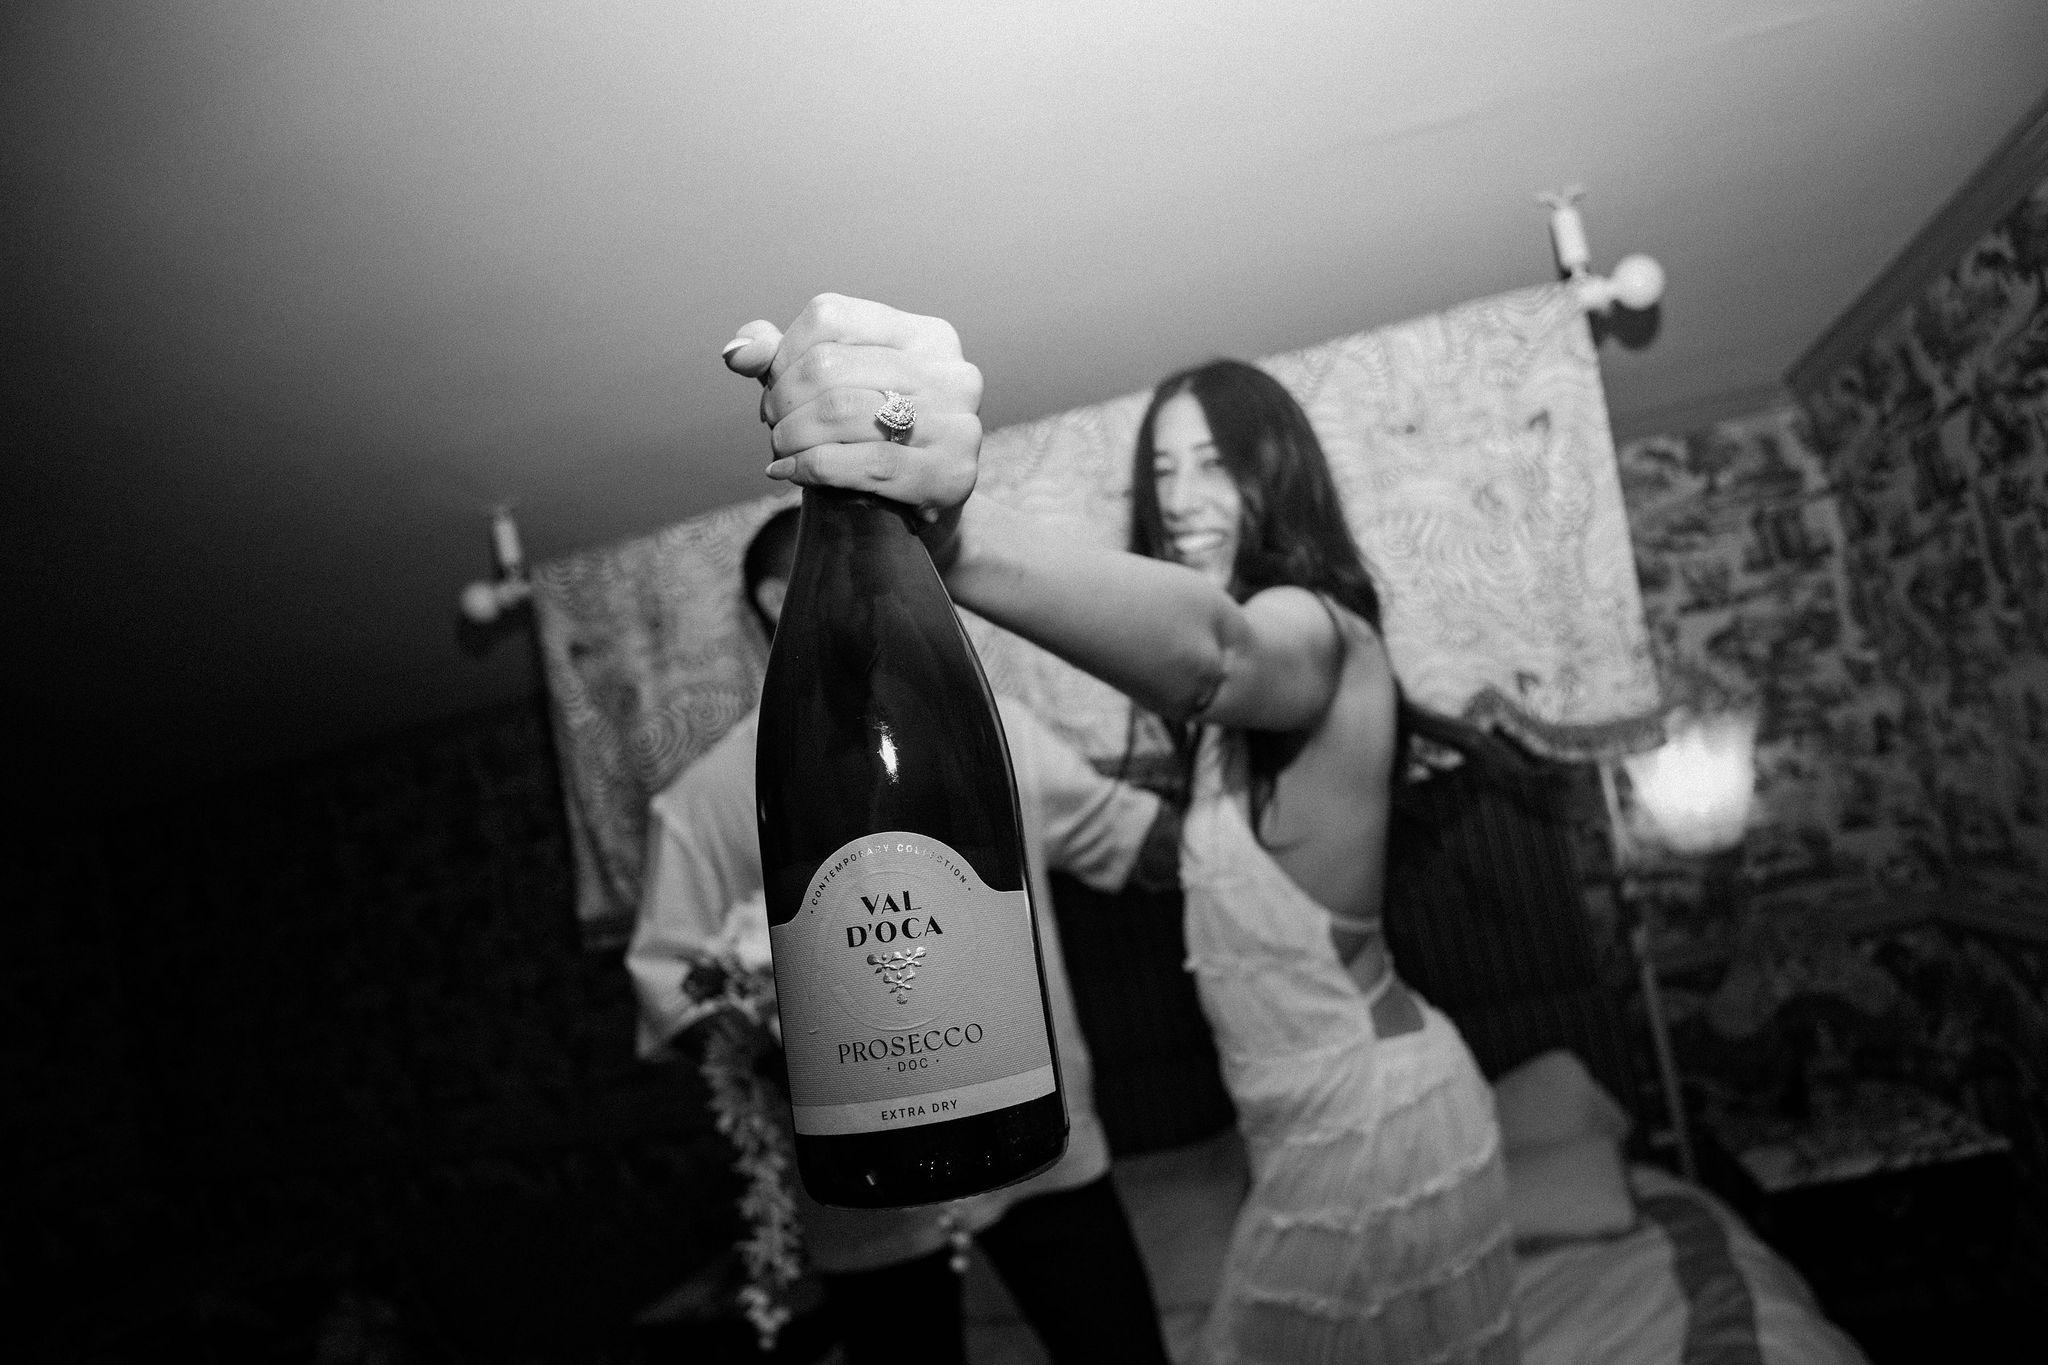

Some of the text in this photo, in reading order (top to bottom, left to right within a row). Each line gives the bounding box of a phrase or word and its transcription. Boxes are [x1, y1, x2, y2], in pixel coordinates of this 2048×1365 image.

[811, 844, 889, 906] CONTEMPORARY
[860, 890, 922, 915] VAL
[846, 915, 943, 948] D'OCA
[838, 1023, 983, 1064] PROSECCO
[897, 1057, 928, 1072] DOC
[881, 1099, 957, 1120] EXTRA DRY
